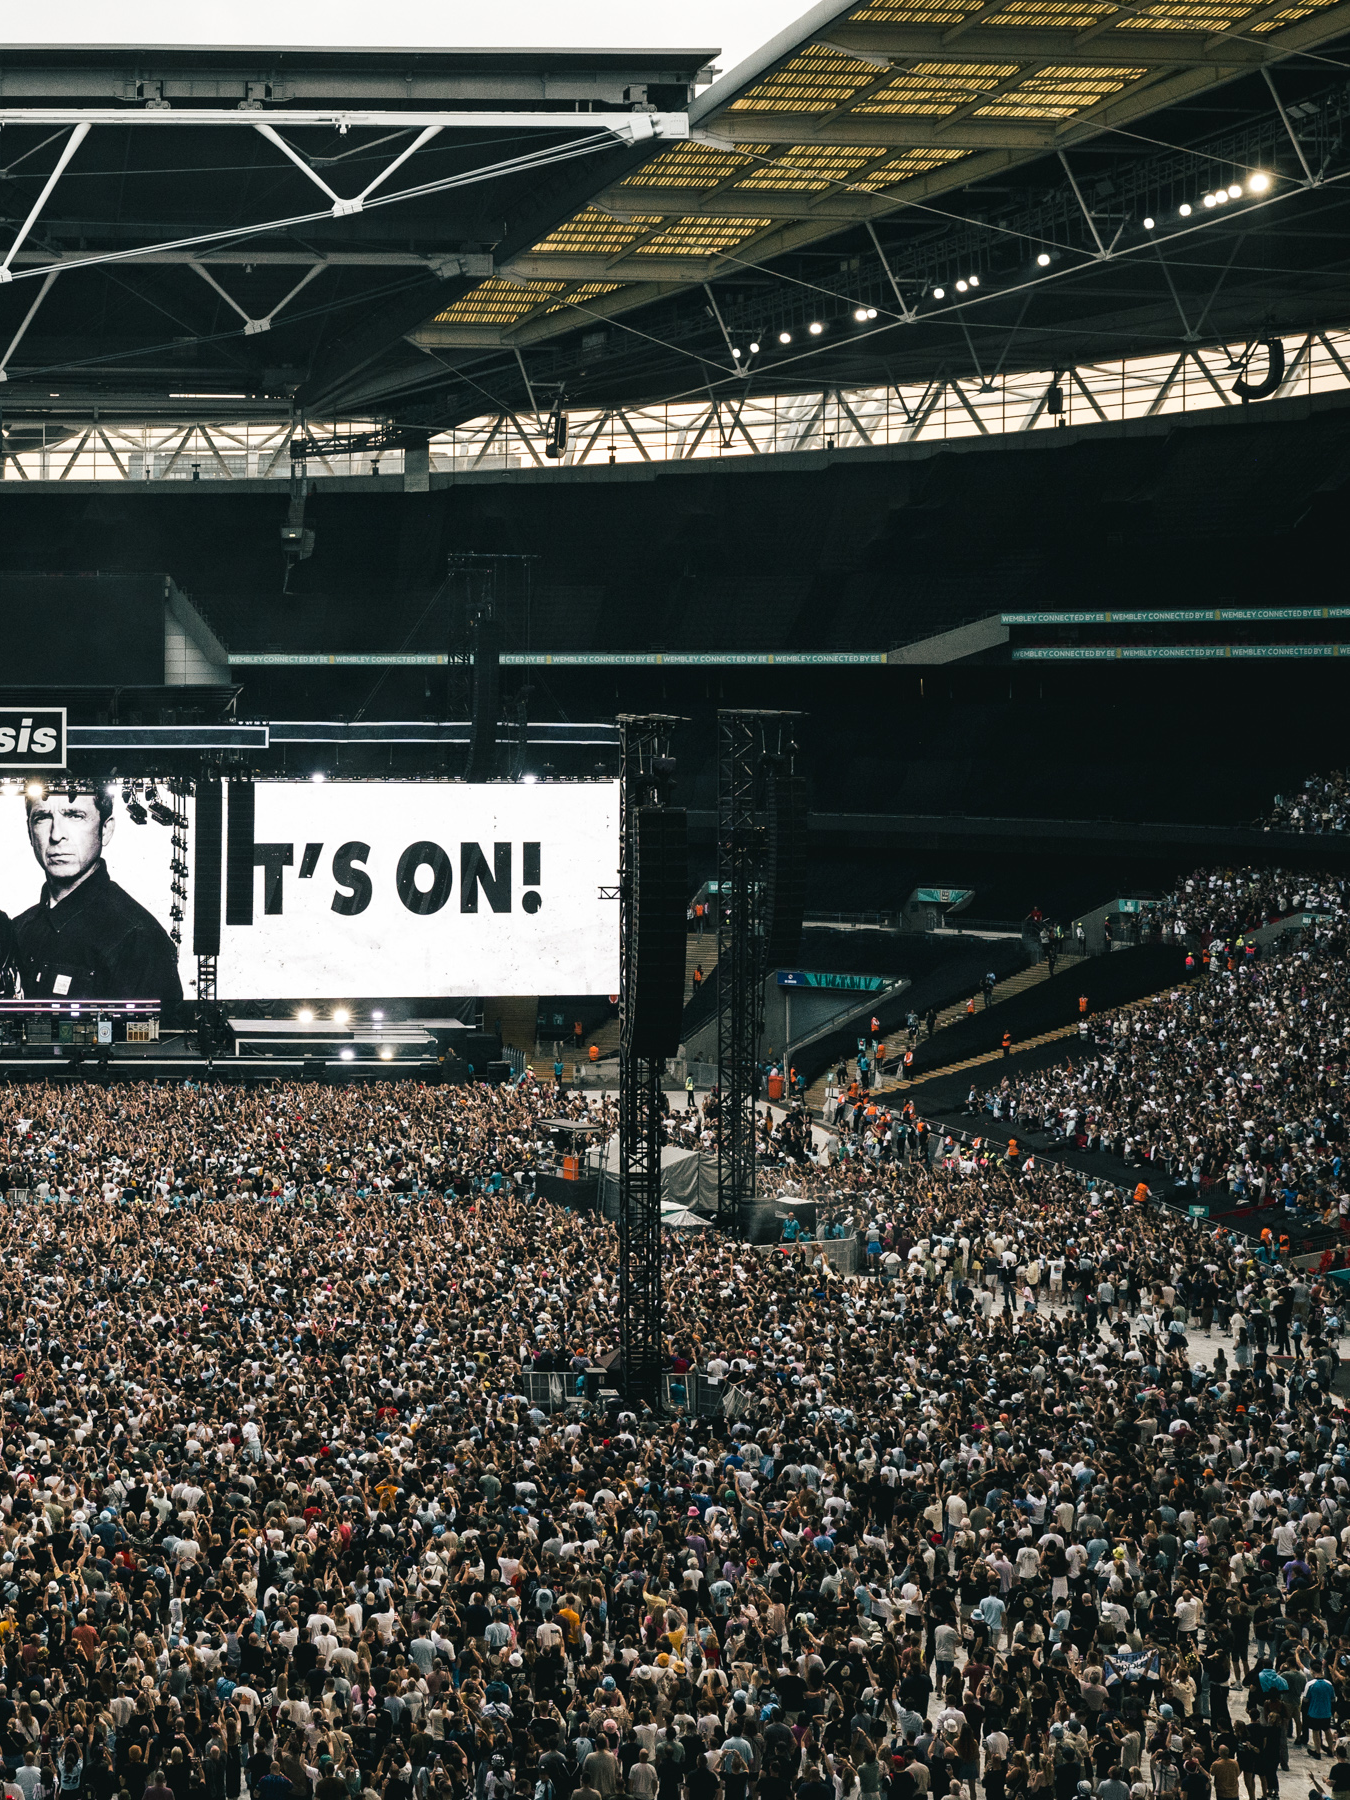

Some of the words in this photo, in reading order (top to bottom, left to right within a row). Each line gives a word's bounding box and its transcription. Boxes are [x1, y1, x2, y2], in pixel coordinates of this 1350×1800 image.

[1112, 613, 1148, 621] WEMBLEY
[1148, 612, 1194, 620] CONNECTED
[1206, 611, 1214, 619] EE
[1222, 611, 1257, 619] WEMBLEY
[1258, 610, 1302, 618] CONNECTED
[1303, 609, 1312, 617] BY
[1313, 609, 1321, 617] EE
[1002, 615, 1037, 623] WEMBLEY
[1038, 614, 1084, 622] CONNECTED
[1014, 650, 1048, 658] WEMBLEY
[1123, 649, 1158, 657] WEMBLEY
[1324, 647, 1332, 655] EE
[229, 656, 263, 664] WEMBLEY
[263, 656, 308, 664] CONNECTED
[309, 656, 319, 664] BY
[320, 656, 328, 664] EE
[336, 656, 370, 664] WEMBLEY
[372, 656, 417, 664] CONNECTED
[417, 656, 426, 664] BY
[428, 656, 436, 664] EE
[537, 656, 545, 664] EE
[553, 656, 588, 664] WEMBLEY
[589, 656, 635, 664] CONNECTED
[636, 656, 645, 664] BY
[647, 656, 655, 664] EE
[664, 656, 698, 664] WEMBLEY
[700, 655, 746, 663] CONNECTED
[747, 655, 757, 663] BY
[759, 655, 767, 663] EE
[775, 655, 811, 663] WEMBLEY
[812, 655, 859, 663] CONNECTED
[860, 655, 870, 663] BY
[871, 655, 879, 663] EE
[254, 842, 373, 916] T'S
[396, 841, 543, 916] ON!
